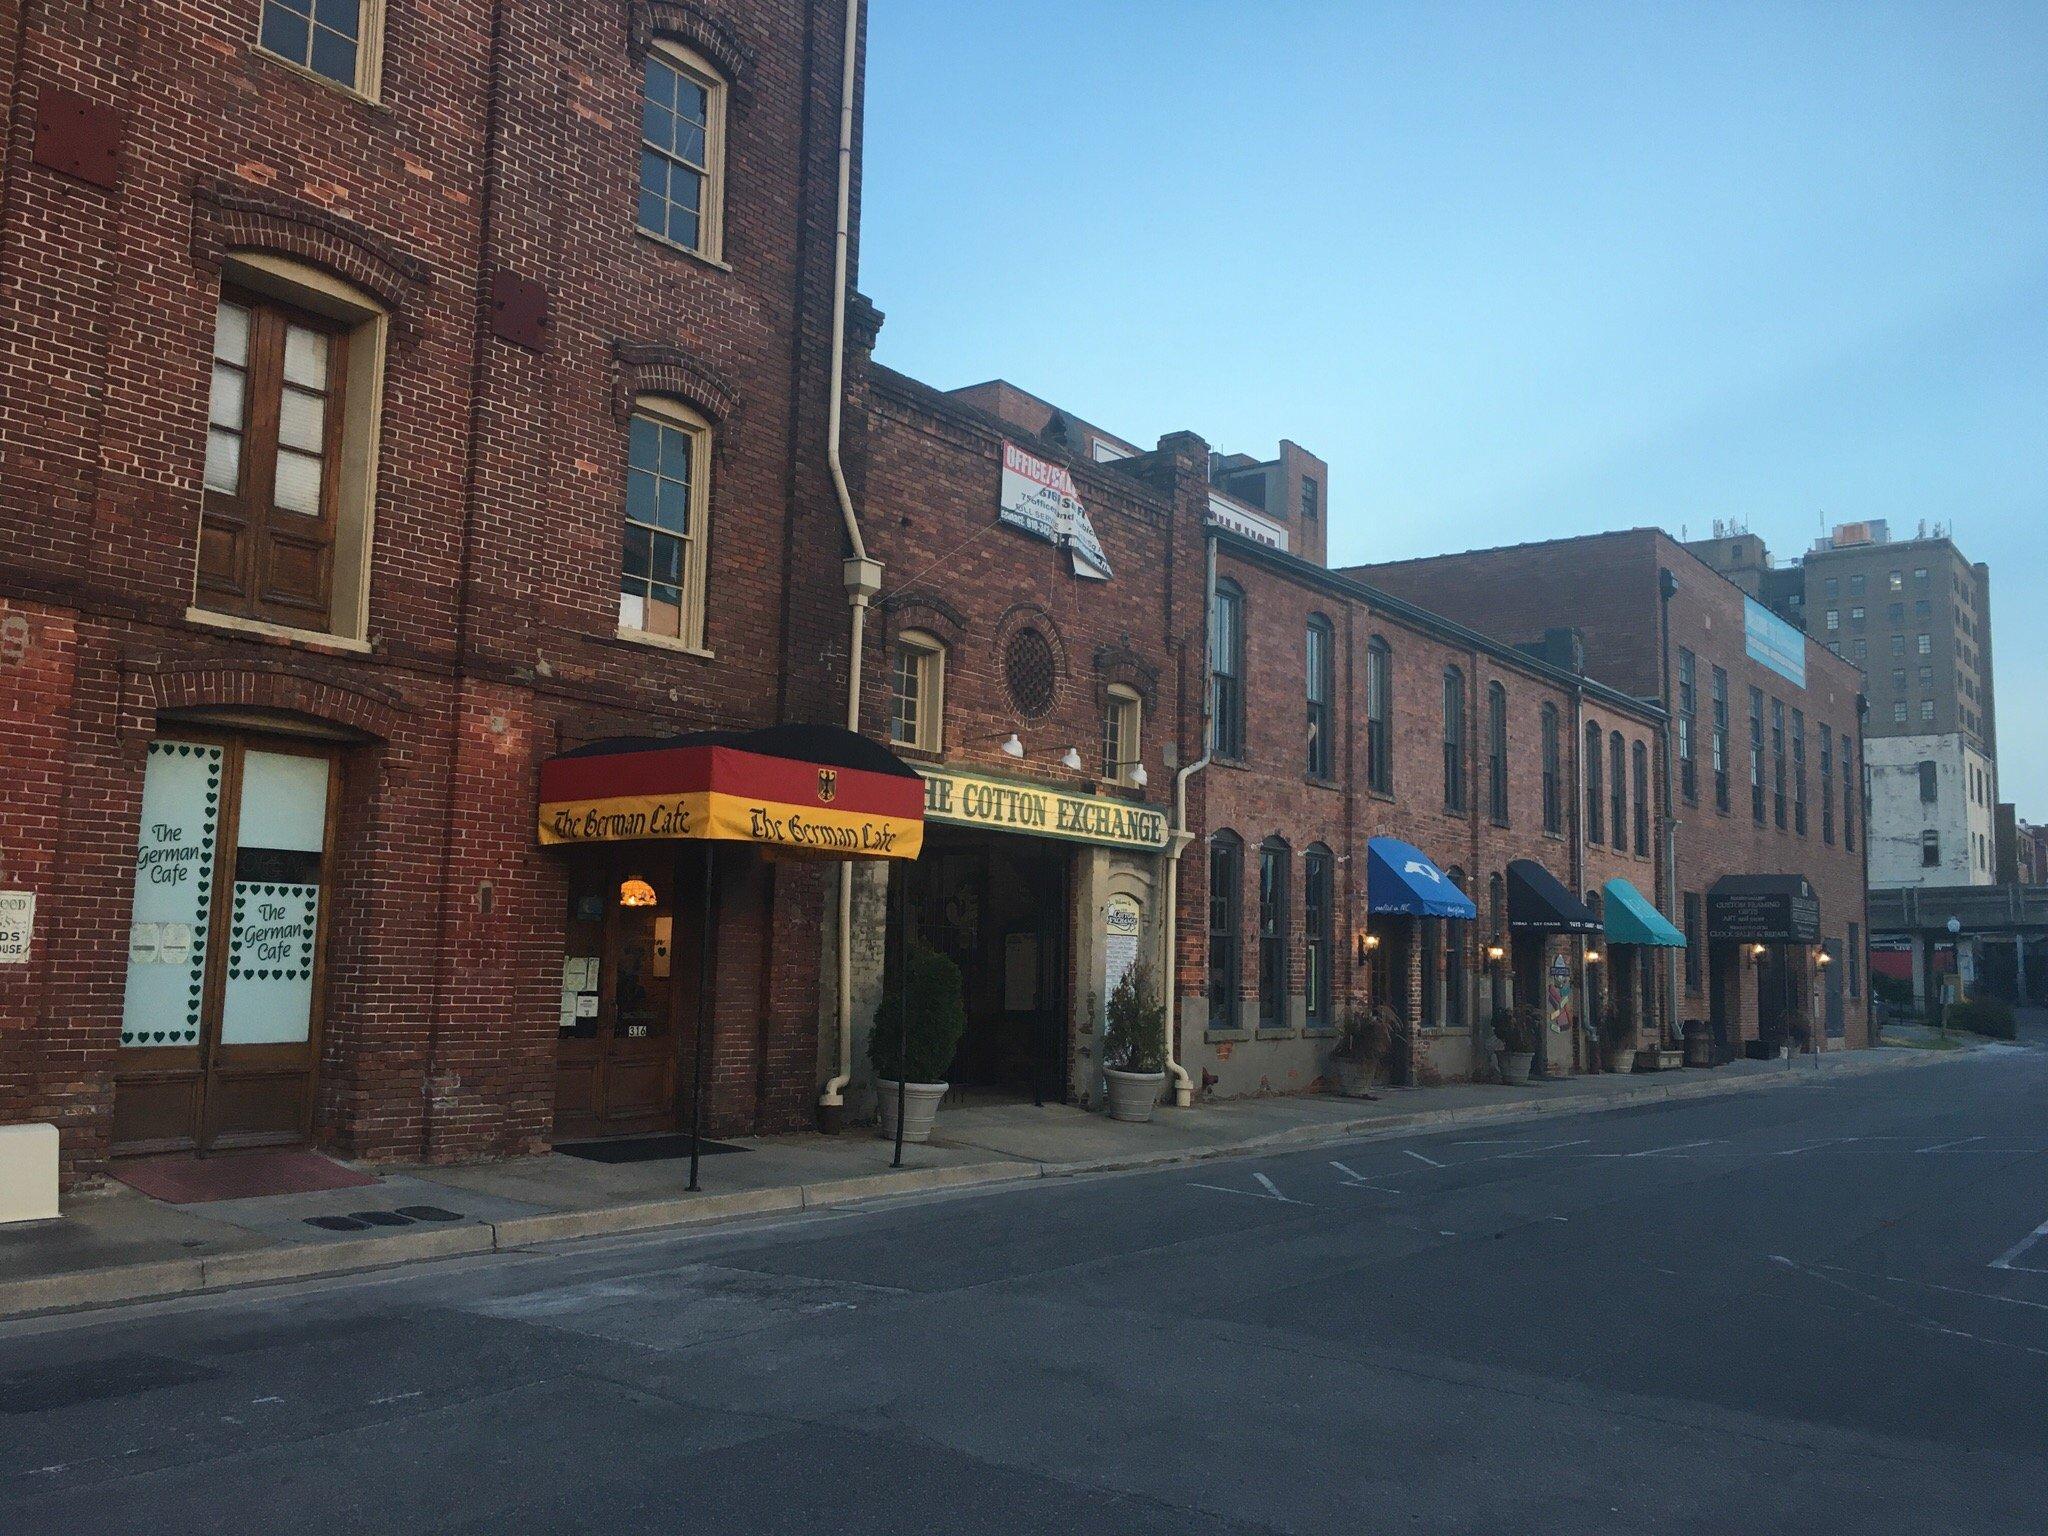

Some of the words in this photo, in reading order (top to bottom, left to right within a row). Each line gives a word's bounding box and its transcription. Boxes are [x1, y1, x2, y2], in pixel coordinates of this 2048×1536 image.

[555, 808, 582, 838] The
[584, 808, 646, 838] German
[650, 800, 691, 834] Cafe
[924, 776, 953, 814] HE
[963, 783, 1047, 827] COTTON
[1056, 798, 1161, 844] EXCHANGE
[152, 824, 182, 842] The
[749, 808, 786, 841] The
[788, 814, 858, 849] German
[862, 823, 896, 852] Cafe
[138, 845, 199, 870] German
[151, 864, 188, 887] Cafe
[259, 903, 286, 921] The
[244, 923, 302, 948] German
[0, 944, 22, 954] USE
[257, 941, 291, 962] Cafe
[629, 1026, 646, 1036] 316
